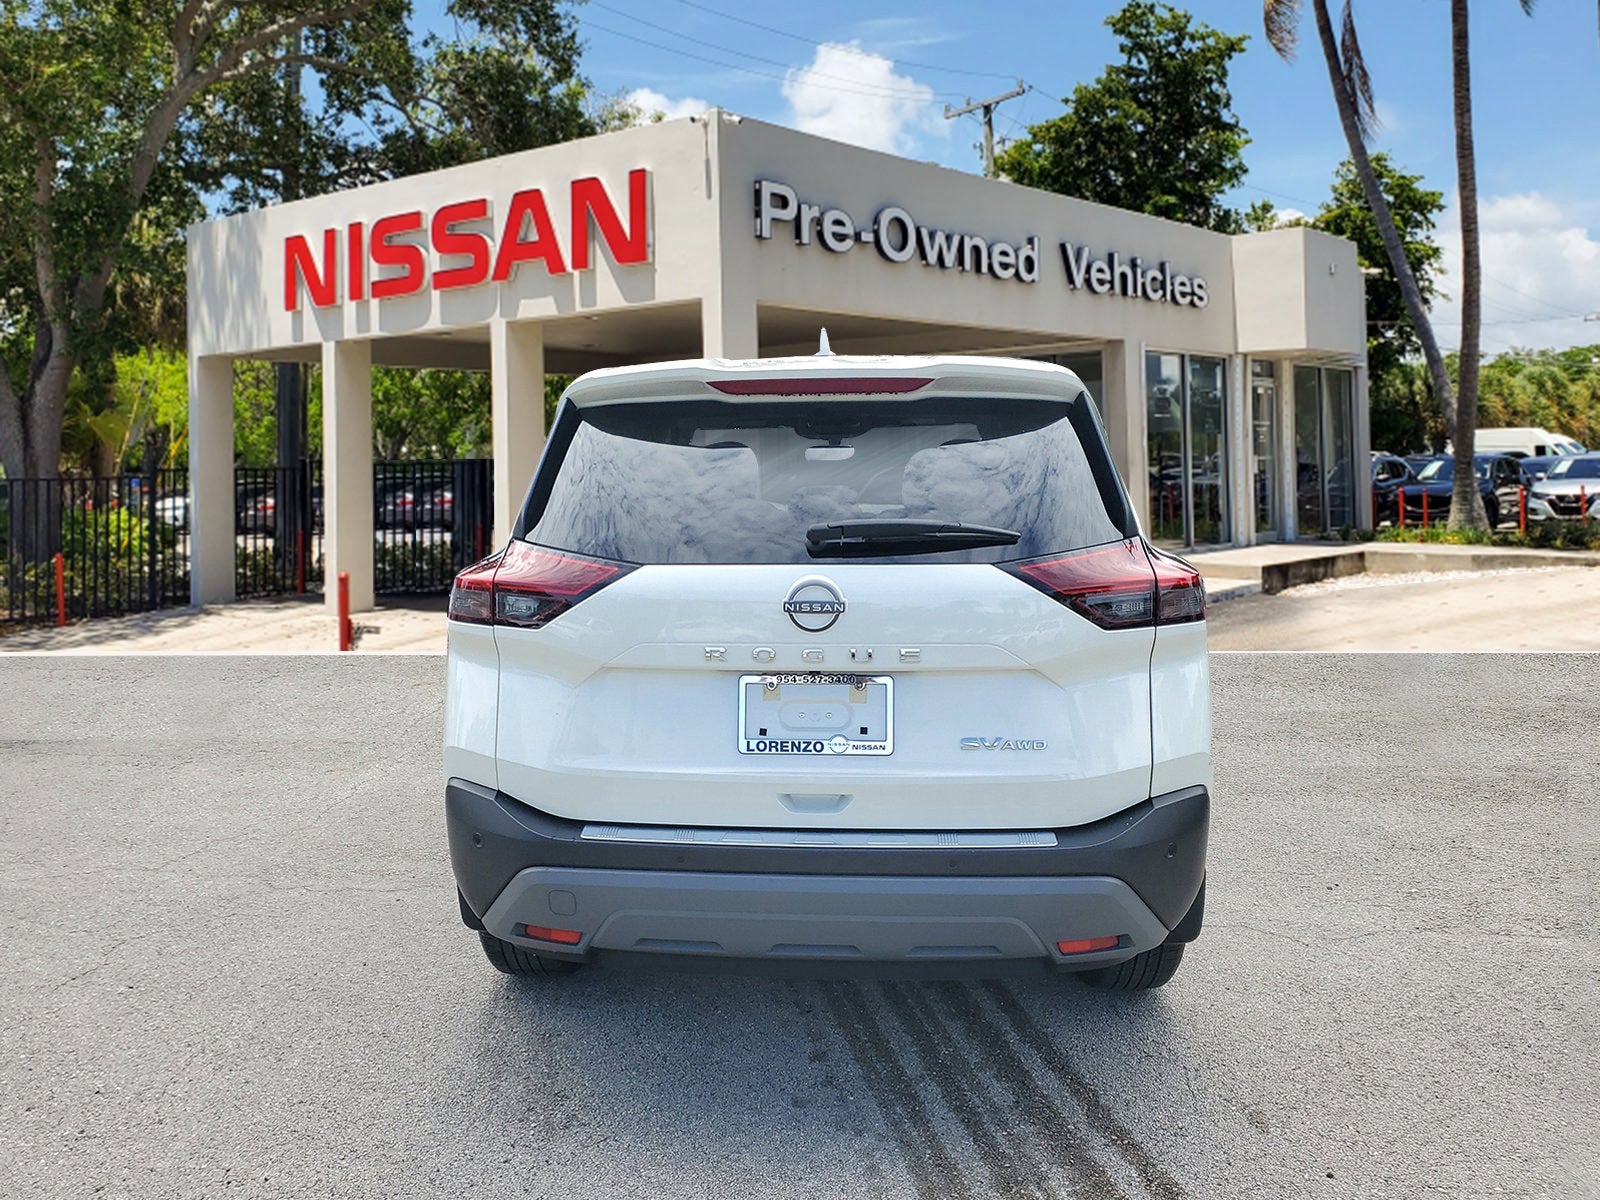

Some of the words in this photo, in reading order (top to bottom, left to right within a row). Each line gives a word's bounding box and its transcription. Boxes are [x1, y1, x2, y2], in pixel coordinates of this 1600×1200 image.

[284, 168, 648, 312] NISSAN
[755, 179, 1040, 284] Pre-Owned
[1060, 242, 1209, 309] Vehicles
[784, 602, 845, 612] NISSAN
[704, 647, 921, 663] ROGUE
[746, 740, 825, 753] LORENZO
[1002, 739, 1048, 751] AWD
